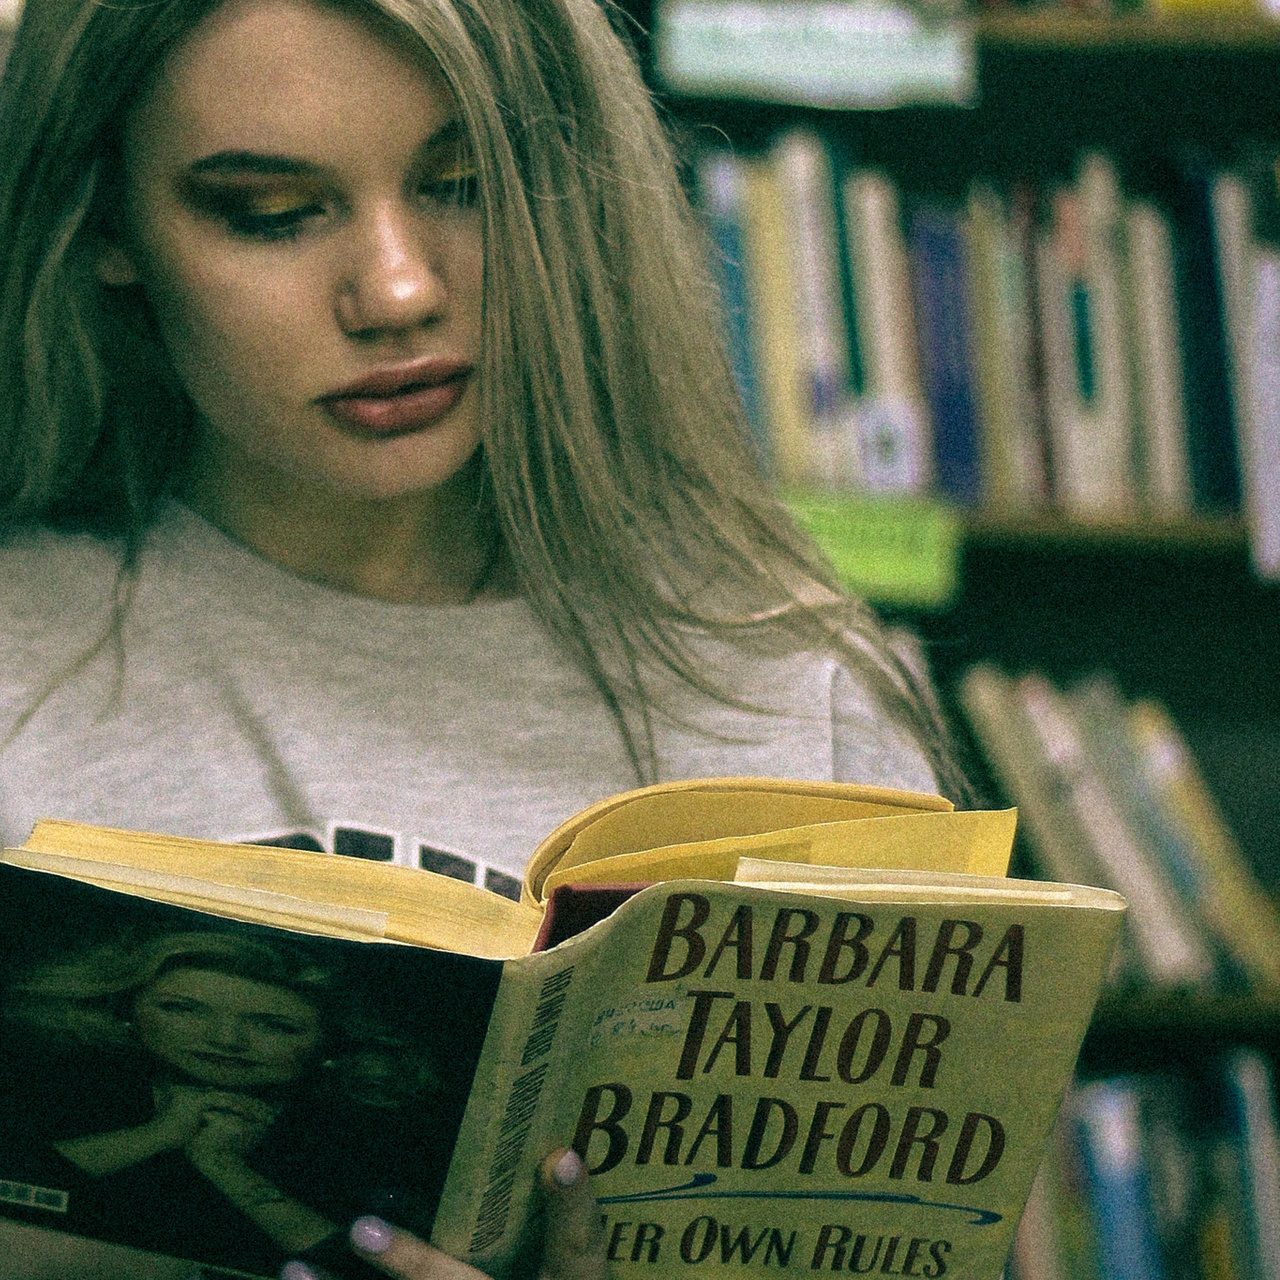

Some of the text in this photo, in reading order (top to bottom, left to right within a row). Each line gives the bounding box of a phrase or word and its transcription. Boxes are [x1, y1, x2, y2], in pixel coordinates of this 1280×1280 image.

[646, 893, 1026, 1004] BARBARA
[675, 990, 953, 1090] TAYLOR
[571, 1083, 1008, 1186] BRADFORD
[602, 1214, 952, 1279] ER OWN RULES
